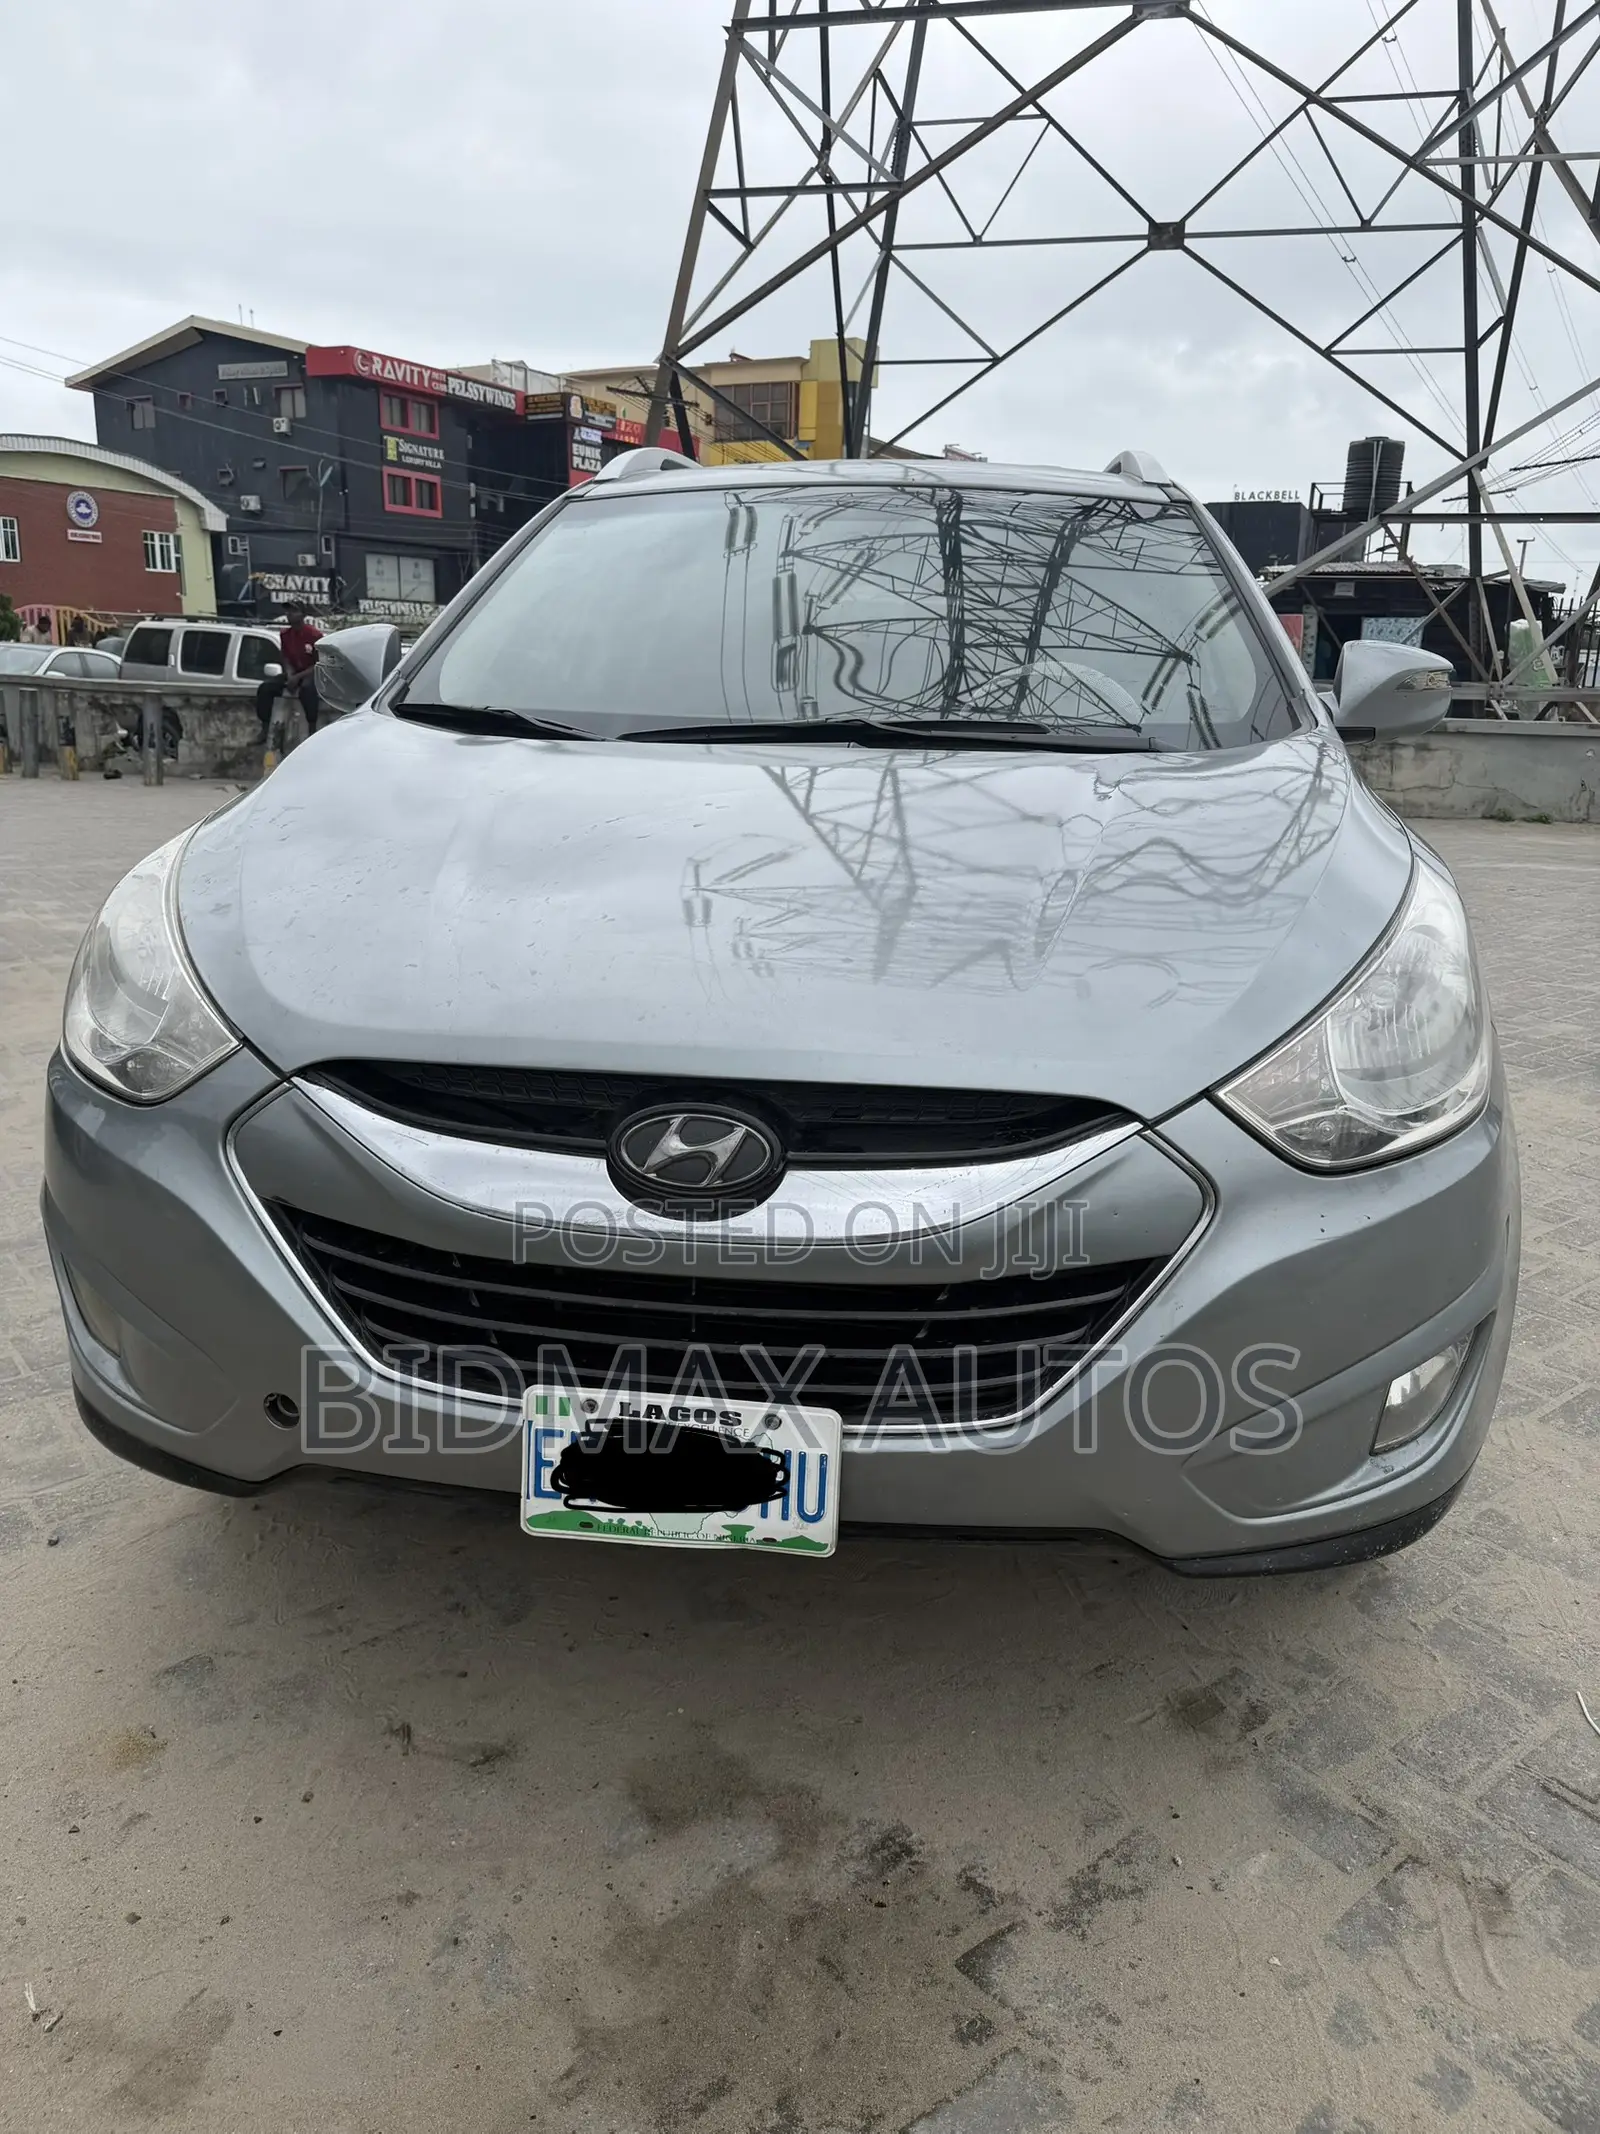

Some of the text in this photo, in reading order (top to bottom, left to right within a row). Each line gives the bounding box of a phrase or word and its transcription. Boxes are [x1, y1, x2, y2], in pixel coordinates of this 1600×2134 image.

[354, 350, 431, 388] GRAVITY
[399, 438, 445, 460] SIGNATURE
[1234, 490, 1300, 500] BLACKBELL
[263, 574, 330, 592] GRAVITY
[619, 1402, 742, 1427] LAGOS
